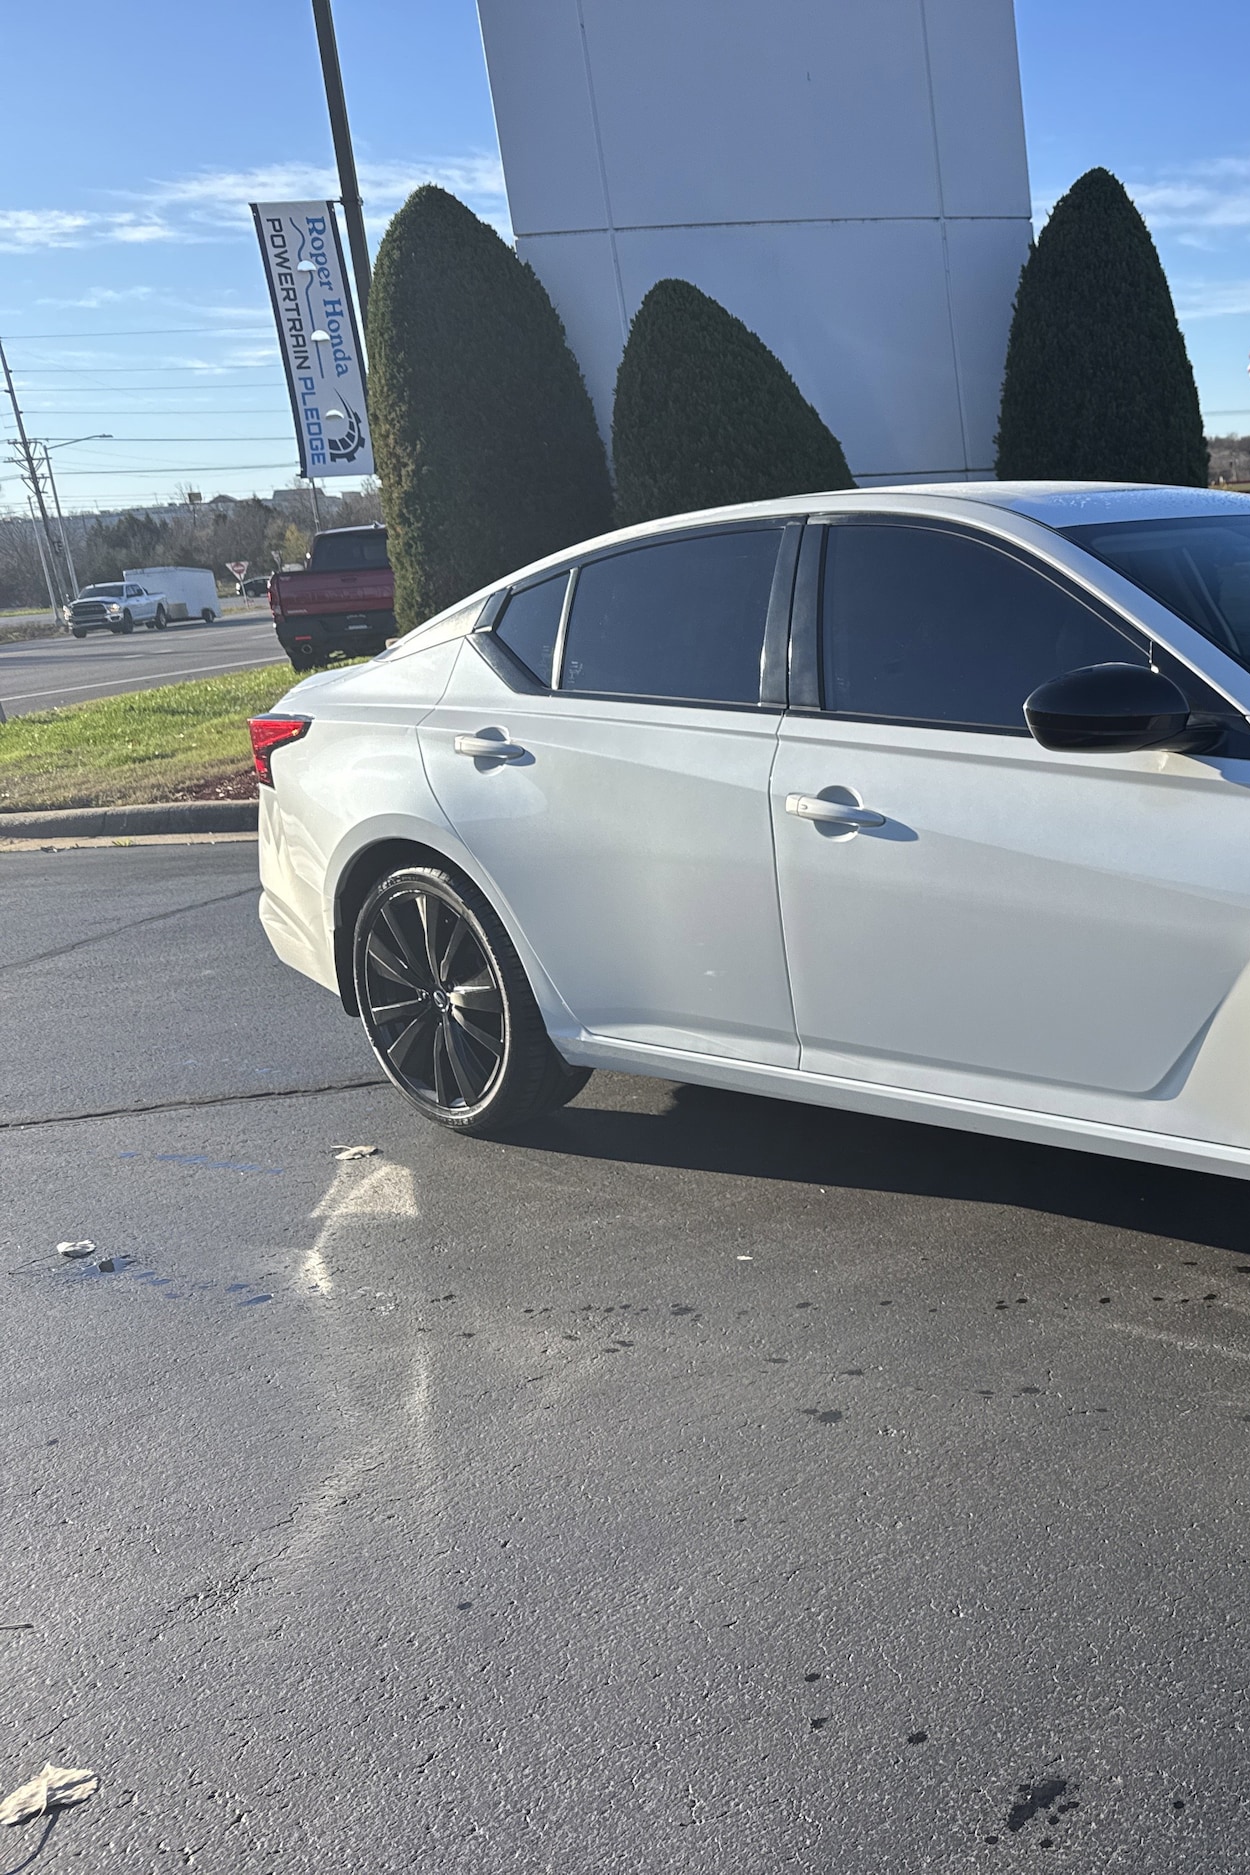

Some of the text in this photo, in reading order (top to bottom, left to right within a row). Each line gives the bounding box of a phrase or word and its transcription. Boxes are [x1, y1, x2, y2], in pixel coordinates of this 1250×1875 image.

[266, 218, 326, 465] POWERTRAIN PLEDGE
[306, 216, 351, 377] Roper Honda
